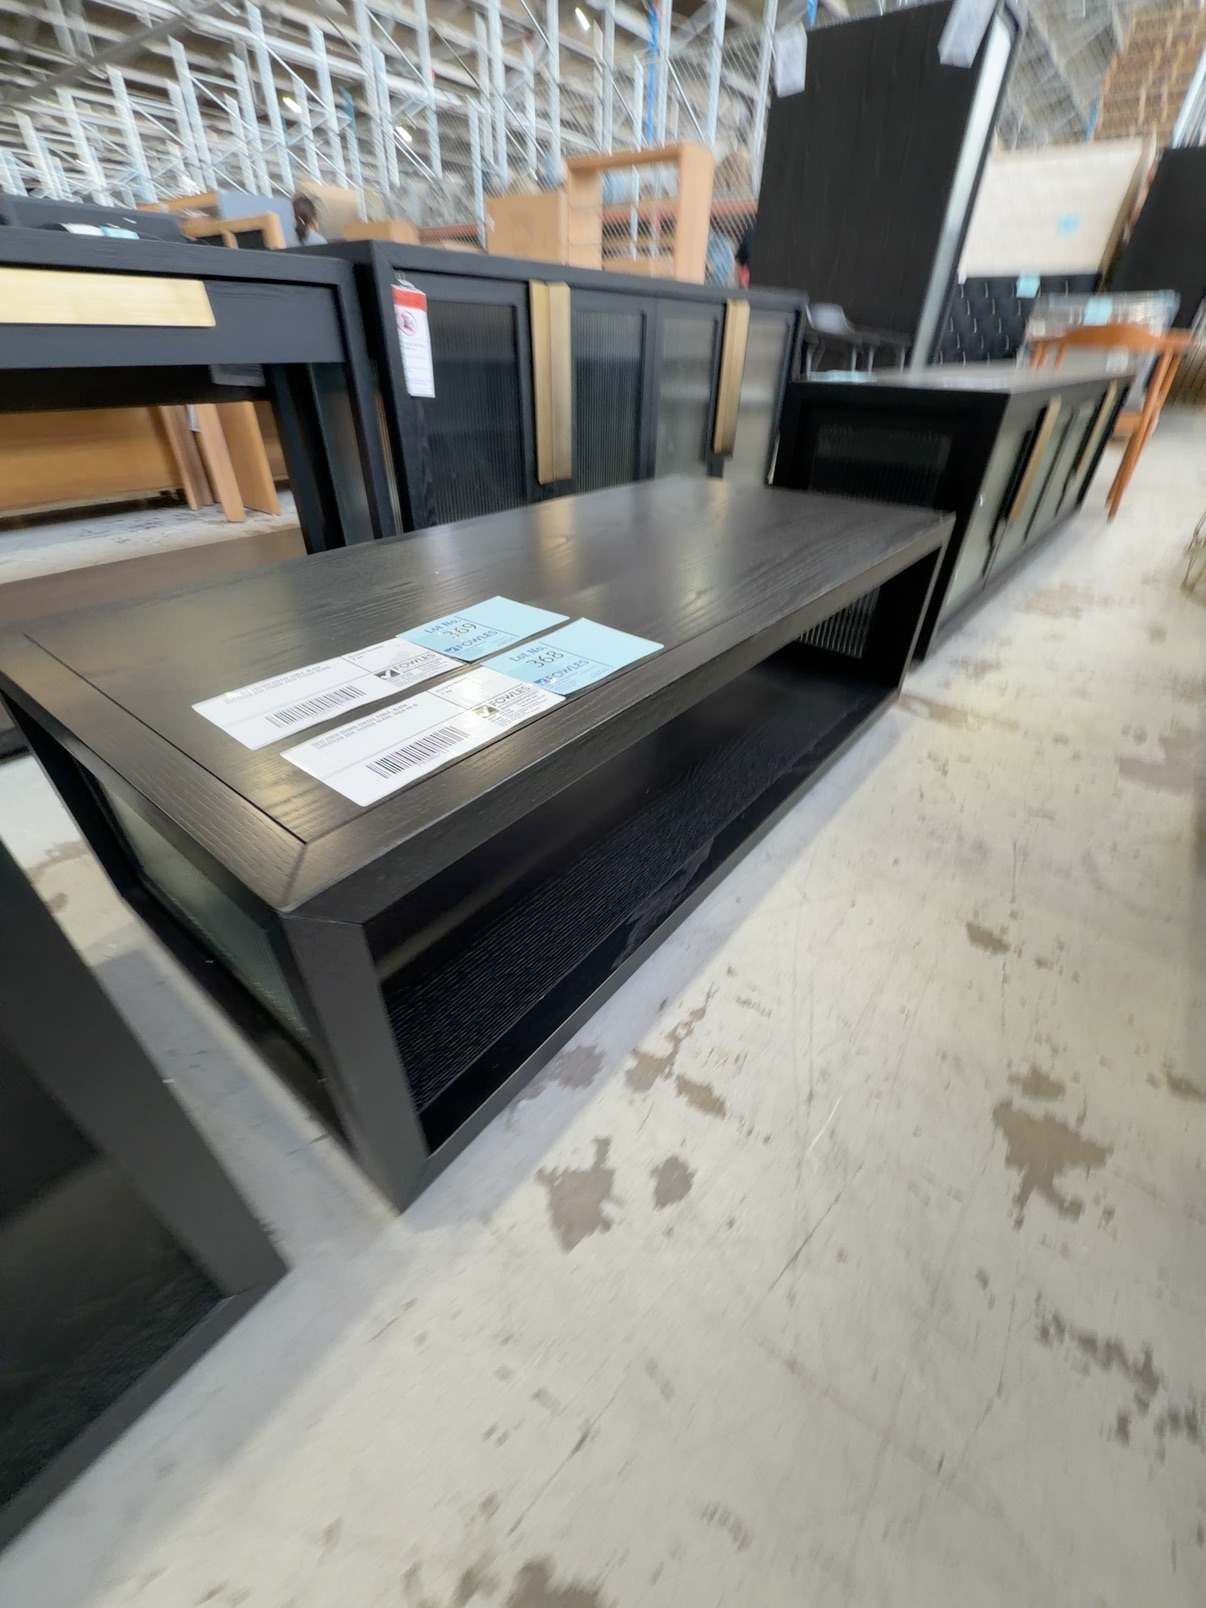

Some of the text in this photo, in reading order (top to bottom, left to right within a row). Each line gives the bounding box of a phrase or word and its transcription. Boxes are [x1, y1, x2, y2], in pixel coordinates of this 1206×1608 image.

[424, 618, 462, 635] Lot No.
[442, 622, 477, 639] 369
[458, 630, 498, 649] FOWLES
[392, 653, 436, 670] FOWLES
[509, 645, 549, 662] Lot No.
[525, 650, 564, 668] 368
[546, 659, 590, 681] FOWLES
[490, 685, 531, 706] FOWLES
